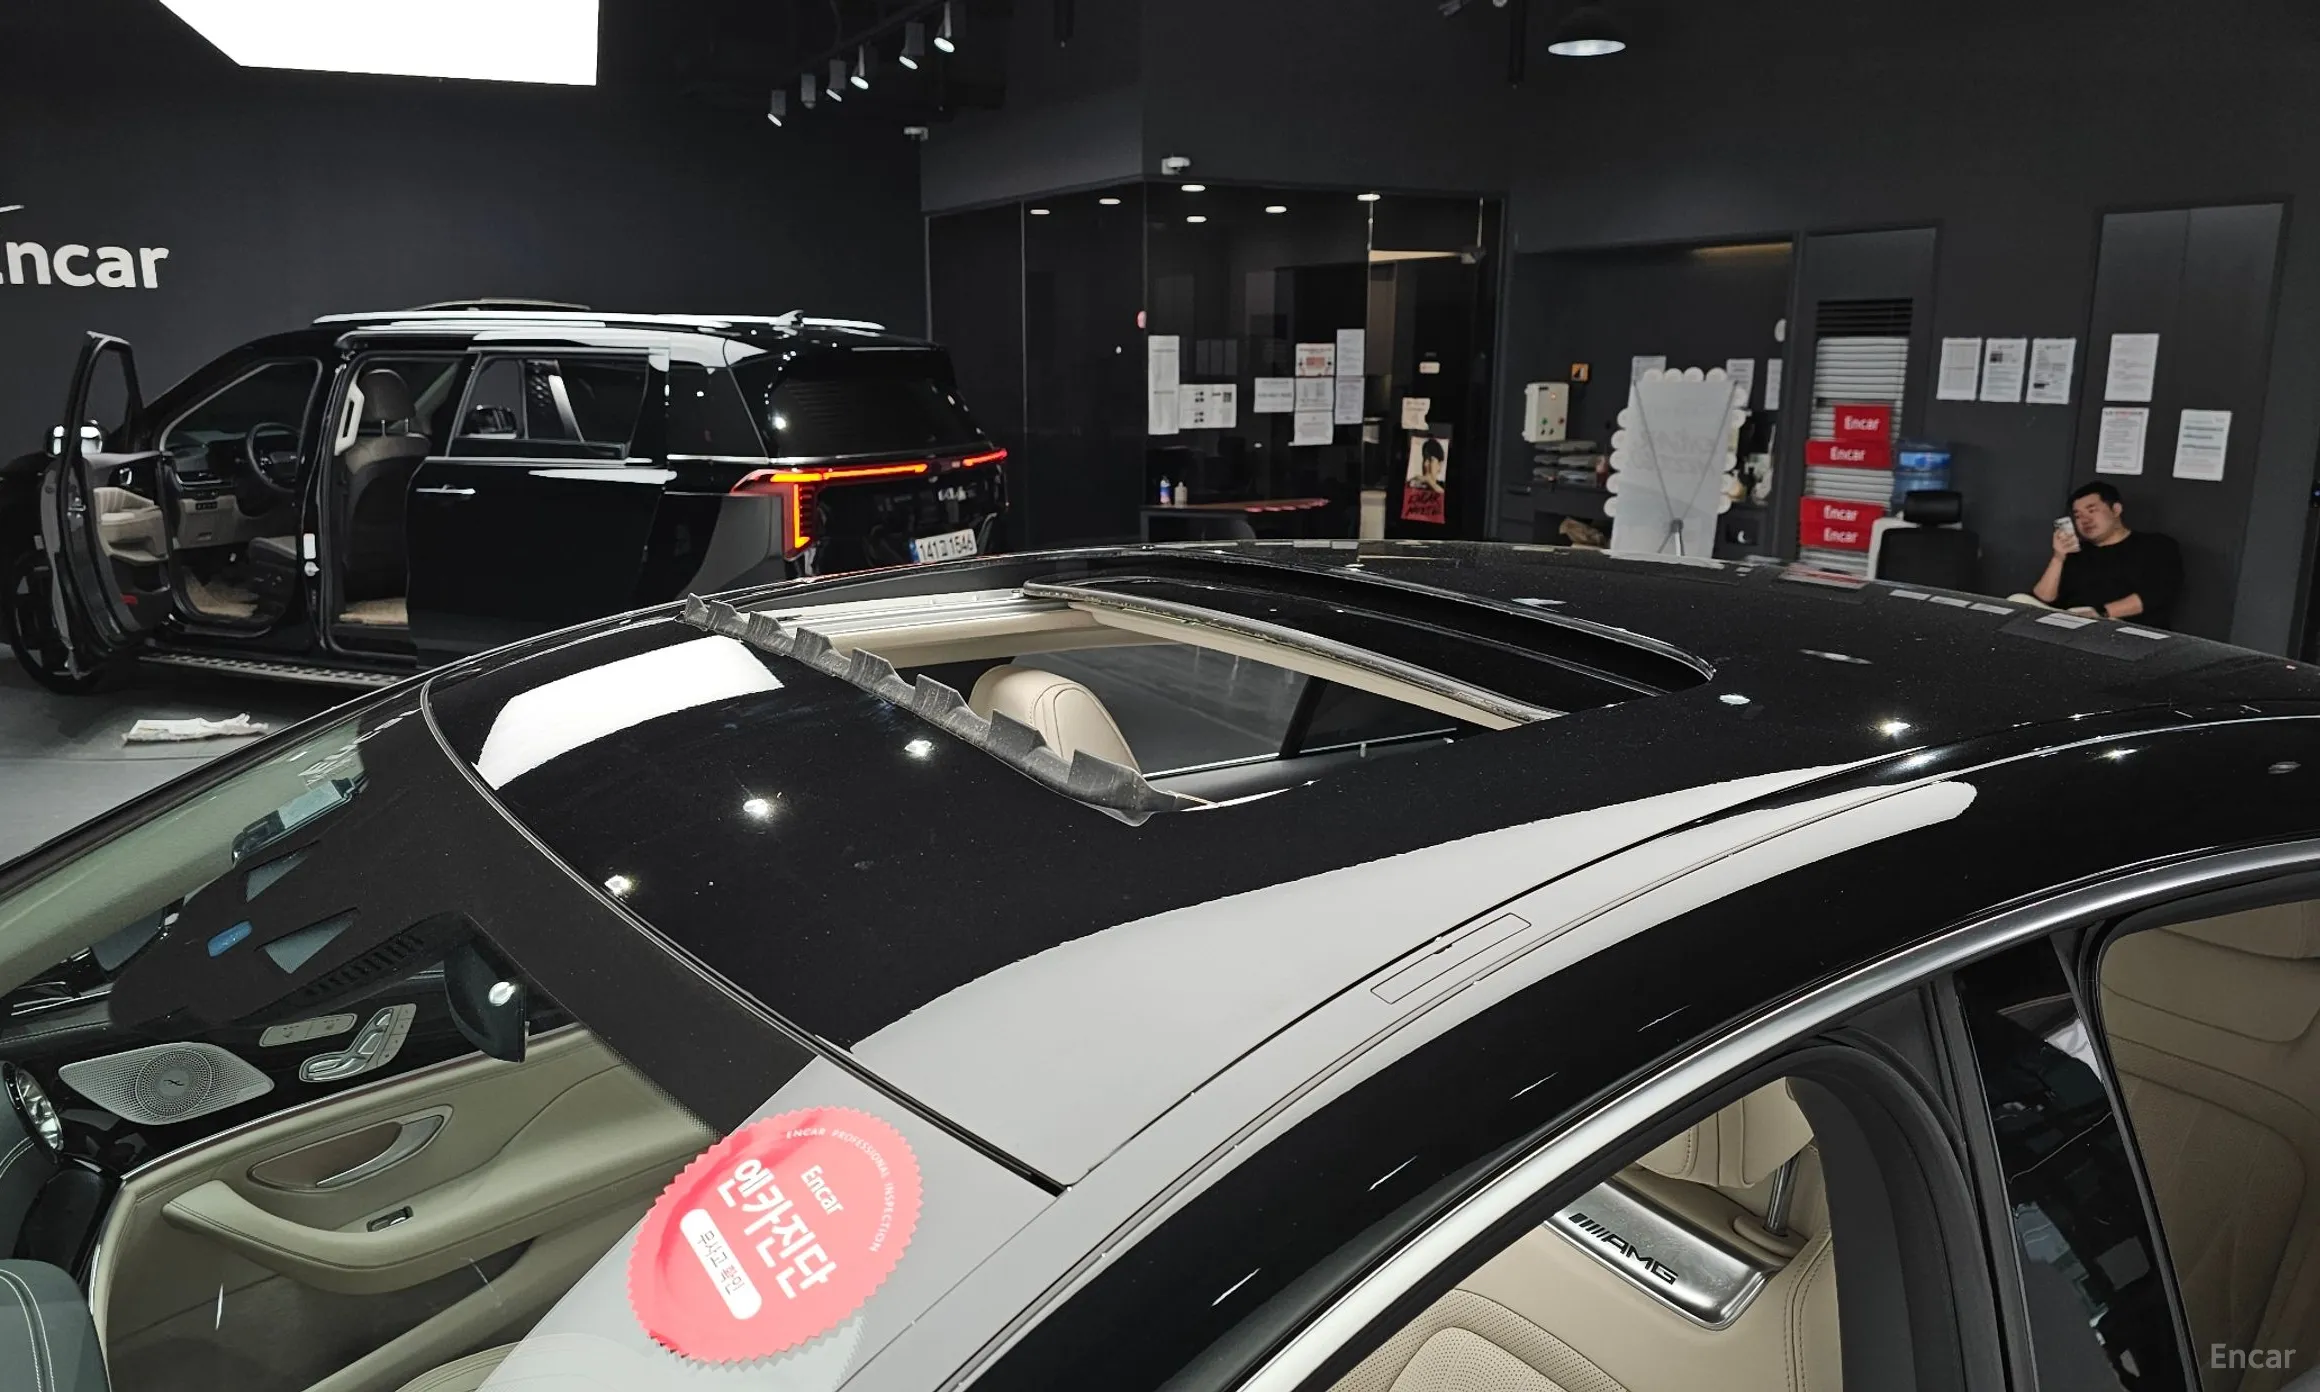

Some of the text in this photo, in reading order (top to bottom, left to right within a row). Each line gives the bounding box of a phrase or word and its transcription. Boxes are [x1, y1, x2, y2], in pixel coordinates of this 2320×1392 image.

[0, 239, 170, 289] ncar
[1843, 415, 1880, 431] Encar
[1829, 446, 1866, 461] Encar
[1823, 504, 1859, 521] Encar
[1823, 526, 1859, 543] Encar
[786, 1127, 896, 1252] ENCAR PROFESSIONAL INSPECTION
[800, 1164, 844, 1215] Encar
[697, 1230, 728, 1268] 무사고
[716, 1158, 837, 1299] 엔카진단
[1603, 1233, 1679, 1285] AMG
